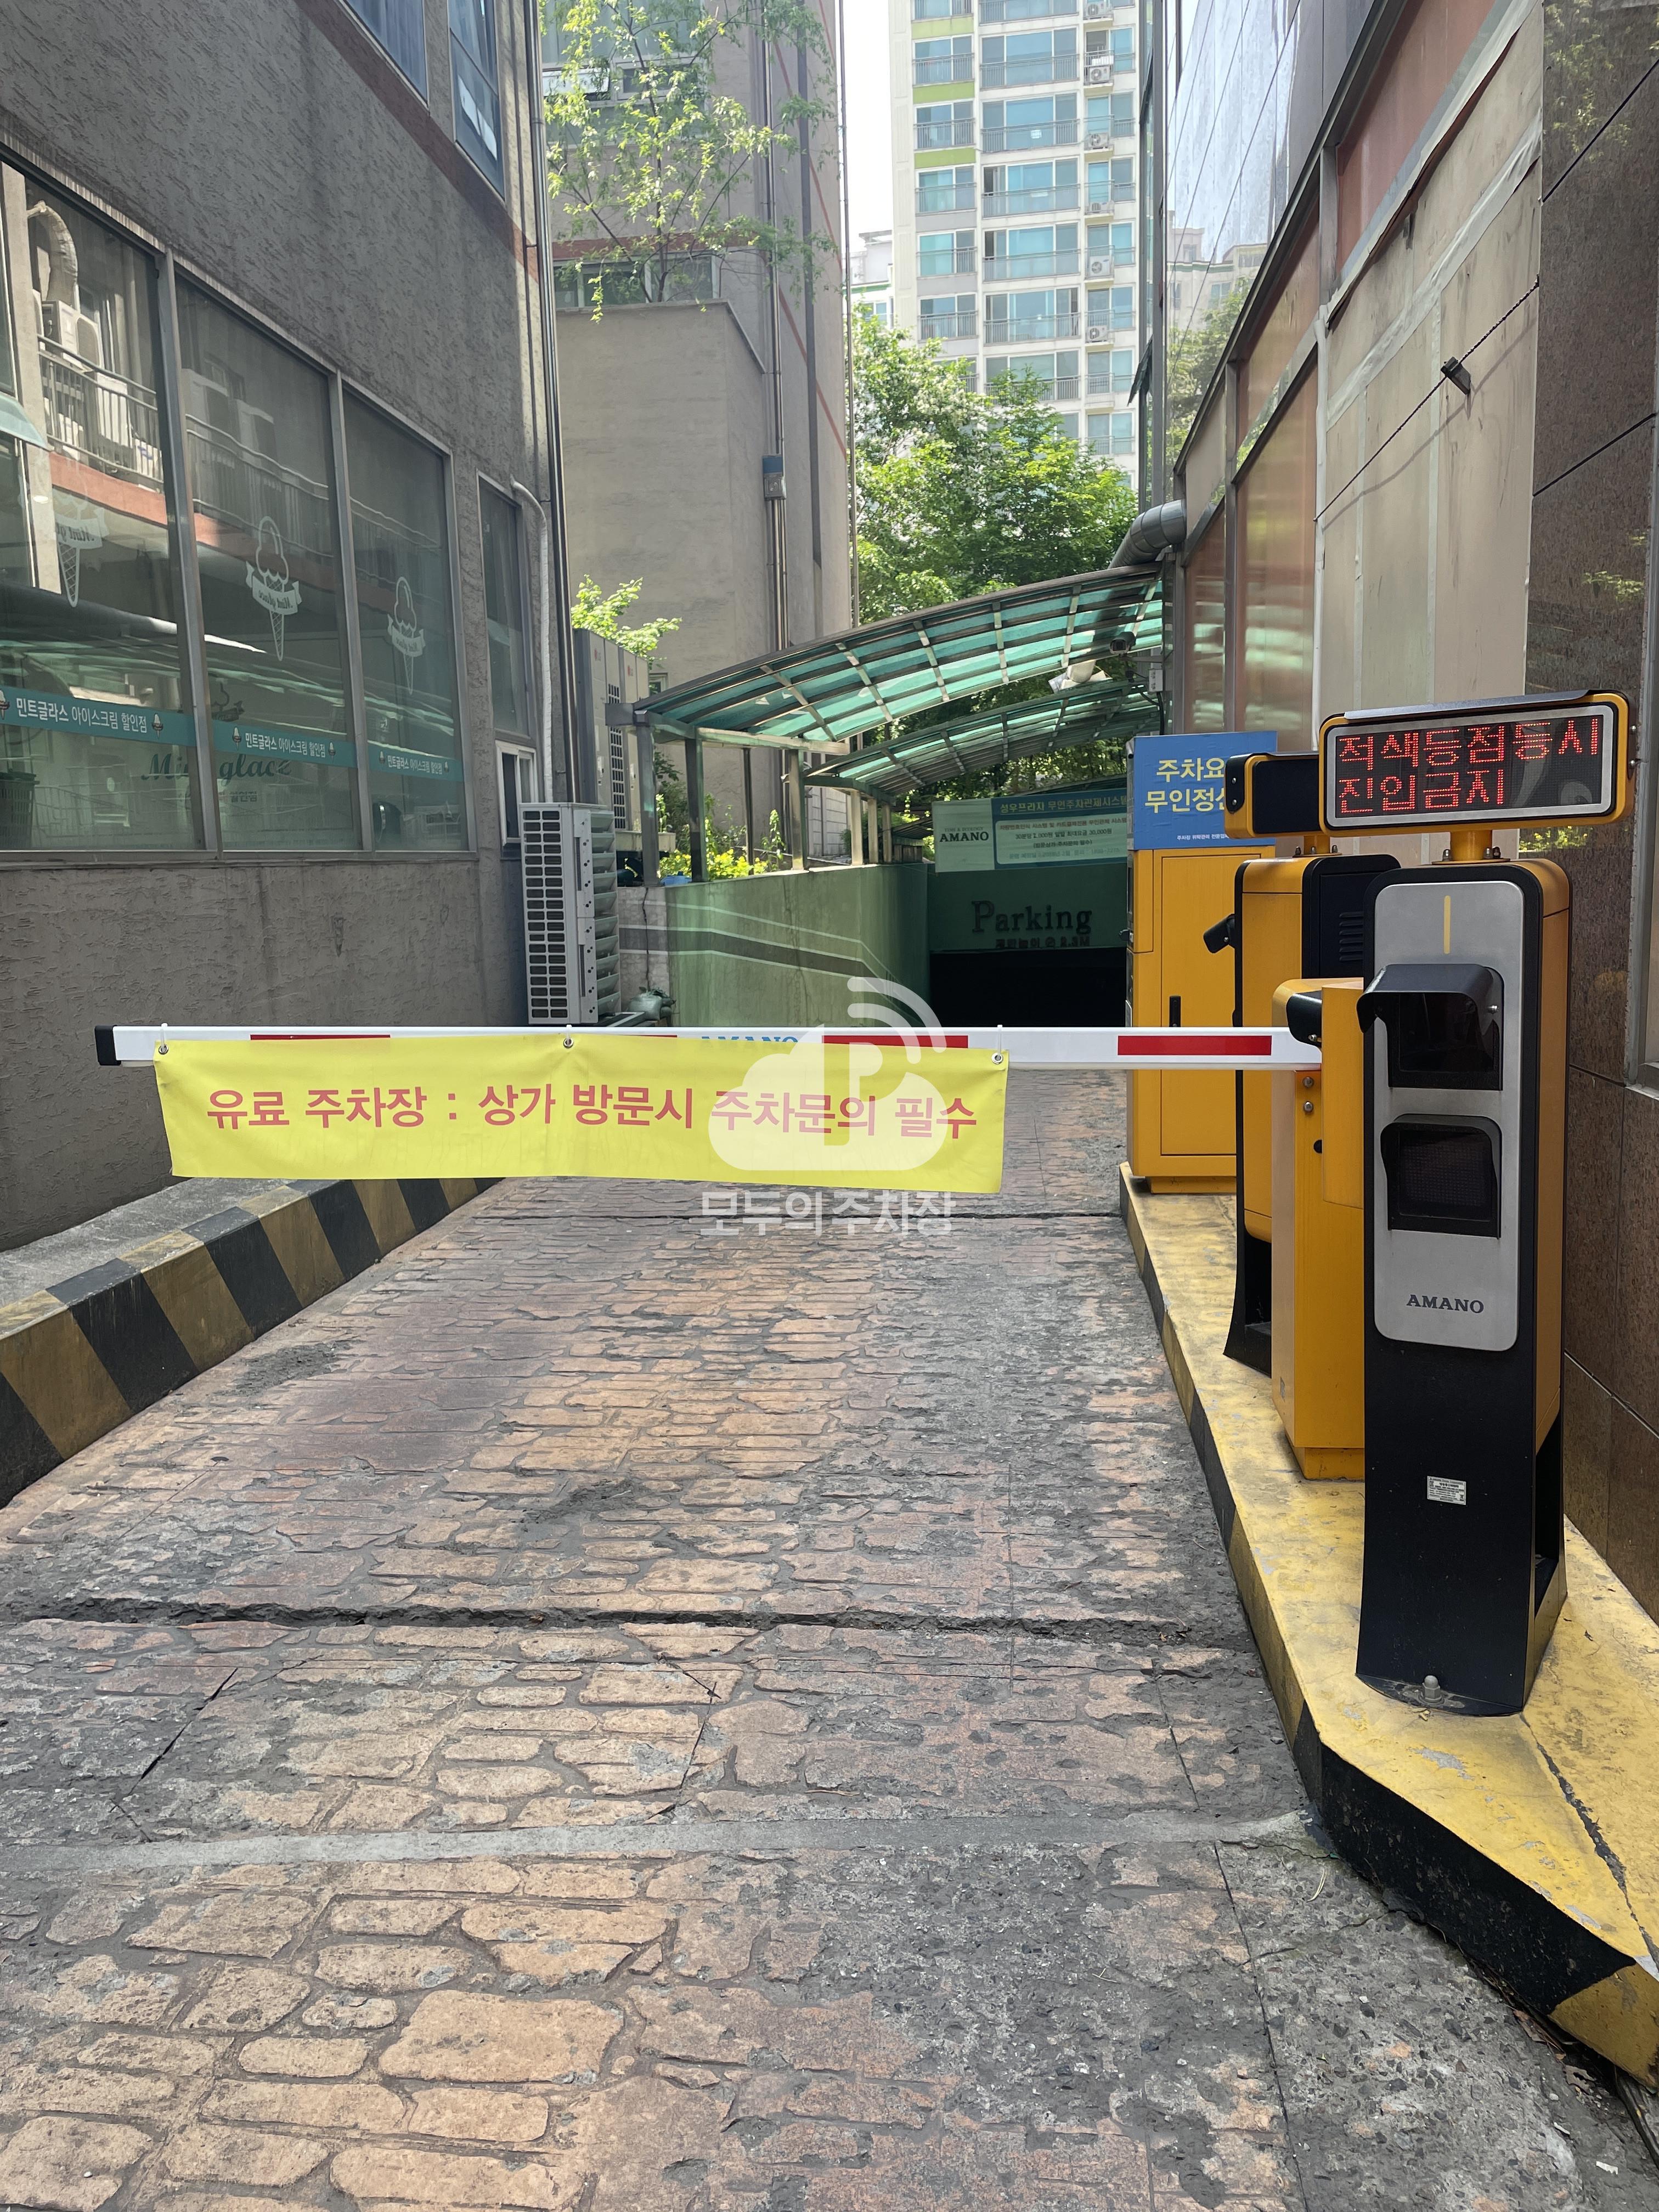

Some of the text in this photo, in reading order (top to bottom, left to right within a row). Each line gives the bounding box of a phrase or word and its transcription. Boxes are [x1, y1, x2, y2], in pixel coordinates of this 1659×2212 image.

[16, 697, 147, 733] 민트글라스 아이스크림 할인점
[245, 732, 326, 758] 민트글라스 아이스크림 할인점
[1339, 718, 1598, 771] 적색등점등시
[387, 755, 410, 769] 민트글라스
[1339, 769, 1504, 813] 진입금지
[939, 831, 989, 843] AMANO
[972, 900, 1092, 934] Parking
[207, 1089, 290, 1130] 유료
[305, 1086, 427, 1128] 주차장
[478, 1084, 556, 1125] 상가
[572, 1084, 692, 1128] 방문시
[712, 1090, 876, 1136] 주차문의
[895, 1097, 977, 1139] 필수
[1406, 1294, 1485, 1314] AMANO
